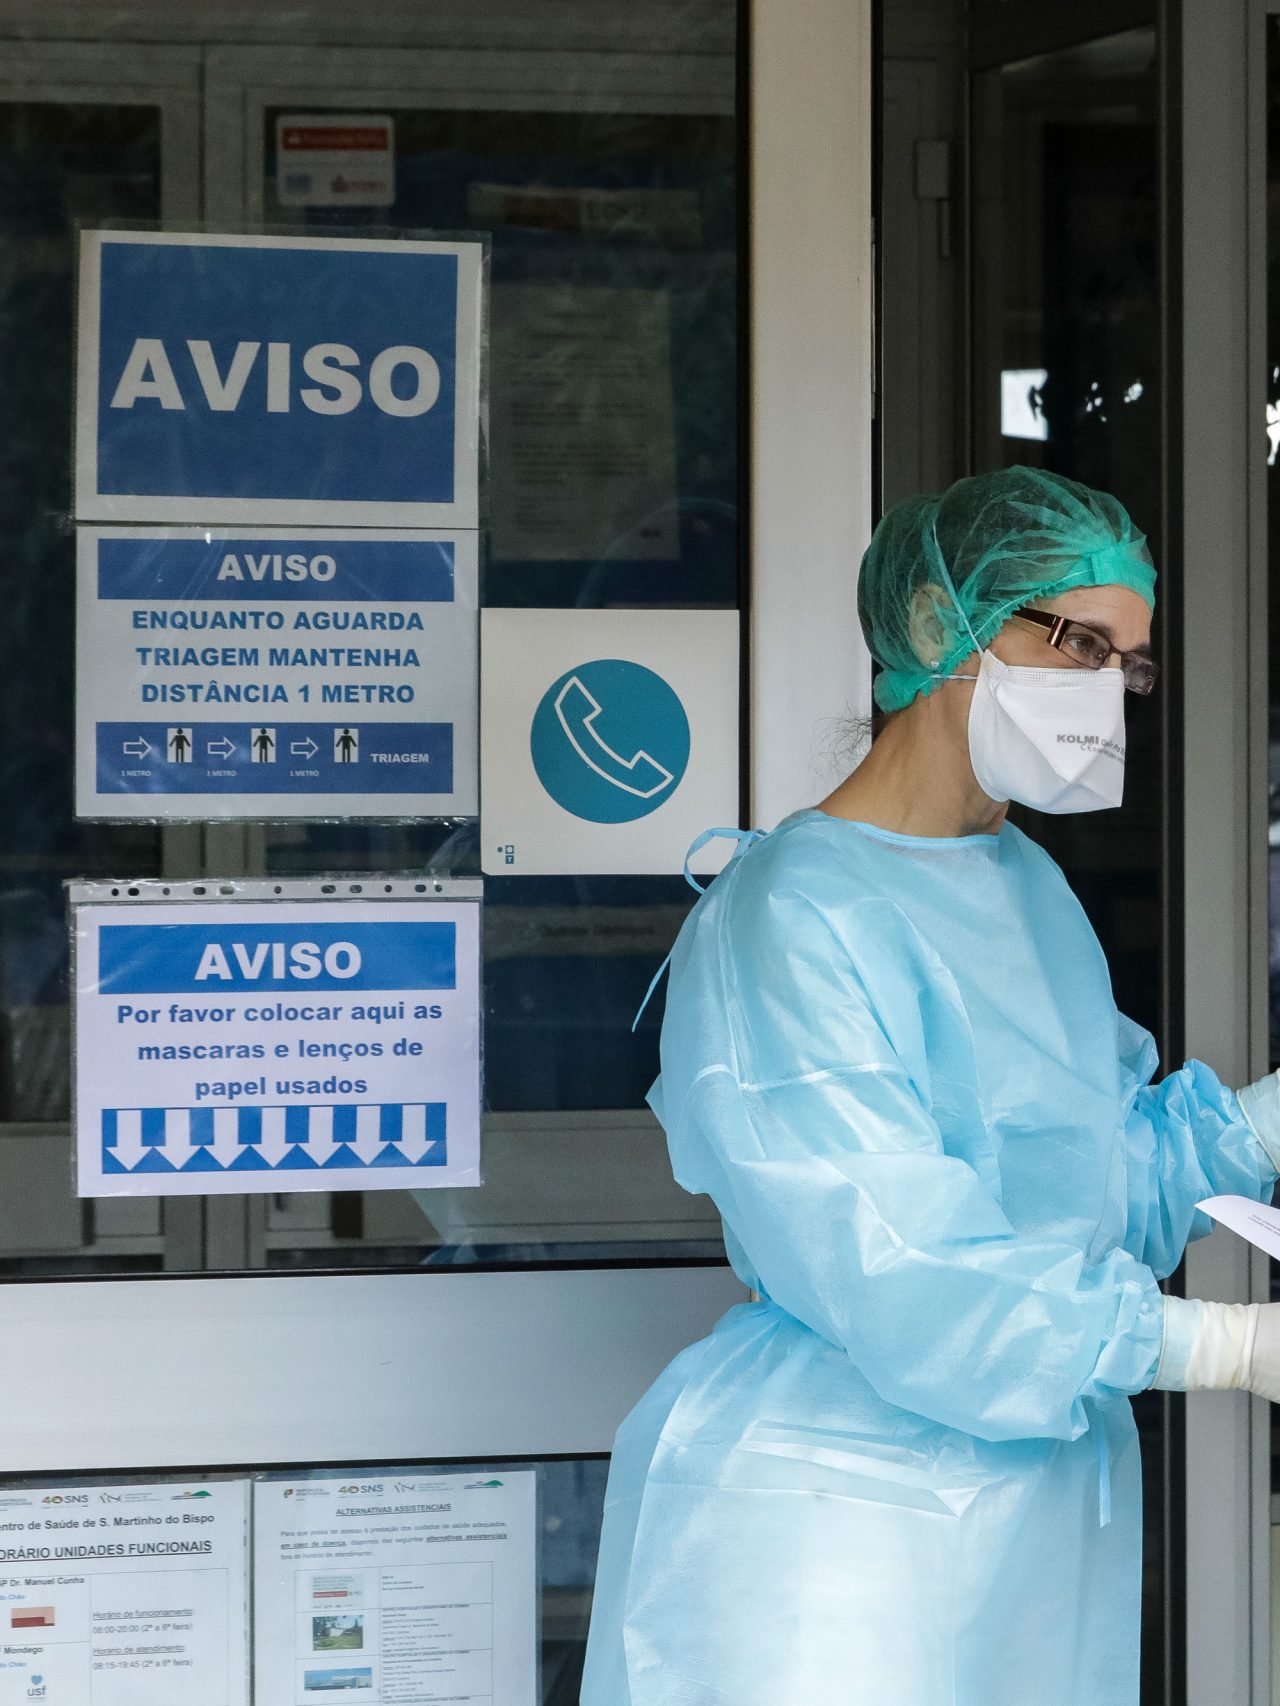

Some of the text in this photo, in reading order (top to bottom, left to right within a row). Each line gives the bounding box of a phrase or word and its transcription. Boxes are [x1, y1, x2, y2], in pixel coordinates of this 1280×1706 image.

[110, 338, 440, 417] AVISO
[217, 554, 337, 582] AVISO
[132, 611, 424, 631] ENQUANTO AGUARDA
[136, 647, 420, 667] TRIAGEM MANTENHA
[142, 680, 415, 703] DISTÂNCIA 1 METRO
[1057, 735, 1099, 745] KOLMI
[370, 754, 430, 764] TRIAGEM
[194, 942, 361, 981] AVISO
[118, 1002, 442, 1024] Por favor colocar aqui as
[138, 1038, 423, 1062] mascaras e lenços de
[195, 1076, 367, 1101] papel usados
[361, 1484, 384, 1493] SNS
[64, 1494, 89, 1504] SNS
[336, 1502, 452, 1516] ALTERNATIVAS ASSISTENCIAIS
[28, 1520, 41, 1529] de
[45, 1519, 79, 1529] Saúde
[83, 1518, 96, 1528] de
[100, 1516, 110, 1527] S.
[114, 1514, 162, 1525] Martinho
[165, 1513, 179, 1524] do
[183, 1512, 214, 1526] Bispo
[427, 1535, 463, 1543] alternativas
[55, 1543, 124, 1558] UNIDADES
[129, 1540, 212, 1555] FUNCIONAIS
[25, 1577, 55, 1585] Manuel
[57, 1576, 85, 1584] Cunha
[93, 1611, 121, 1619] Horário
[4, 1646, 43, 1656] Mondego
[93, 1647, 121, 1656] Horário
[27, 1684, 46, 1697] usf
